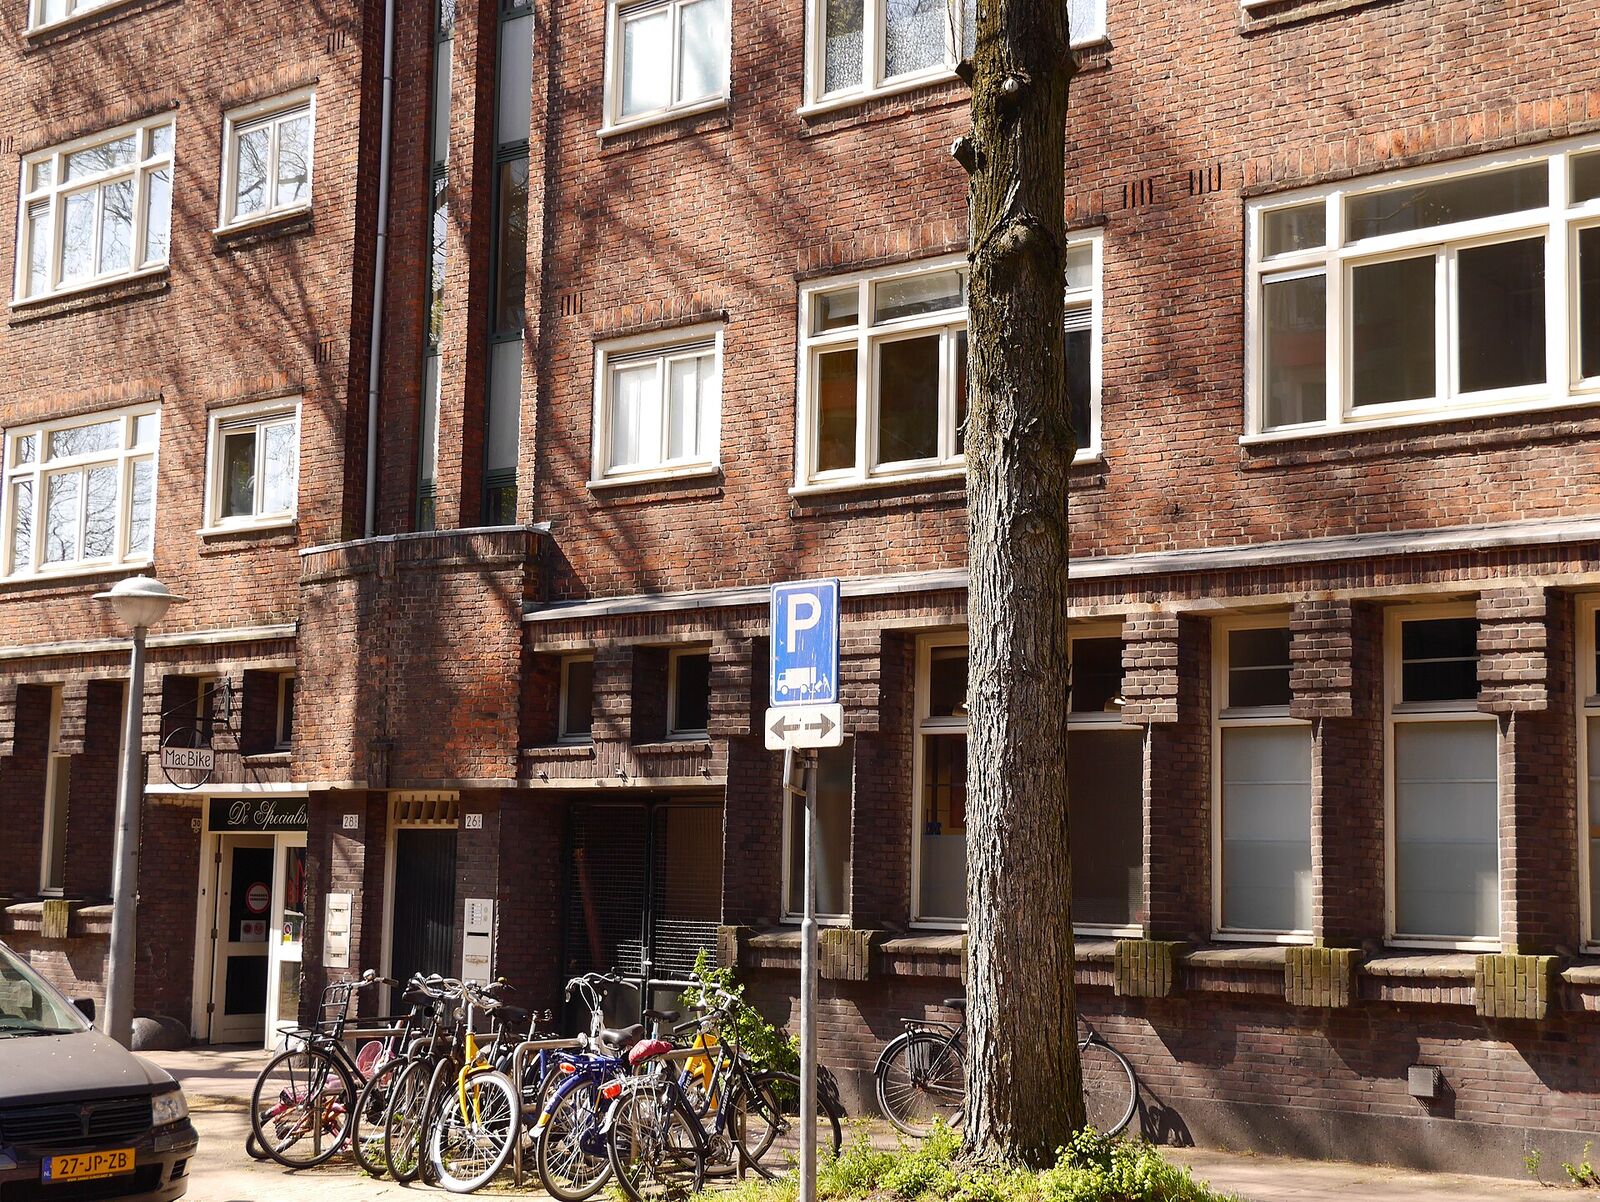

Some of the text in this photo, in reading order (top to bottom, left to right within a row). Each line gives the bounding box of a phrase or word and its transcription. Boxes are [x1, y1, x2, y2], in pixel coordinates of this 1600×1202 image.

[786, 593, 822, 653] P
[227, 800, 252, 825] De
[344, 816, 354, 827] 28
[466, 815, 478, 827] 26
[60, 1152, 127, 1175] 27-JP-ZB
